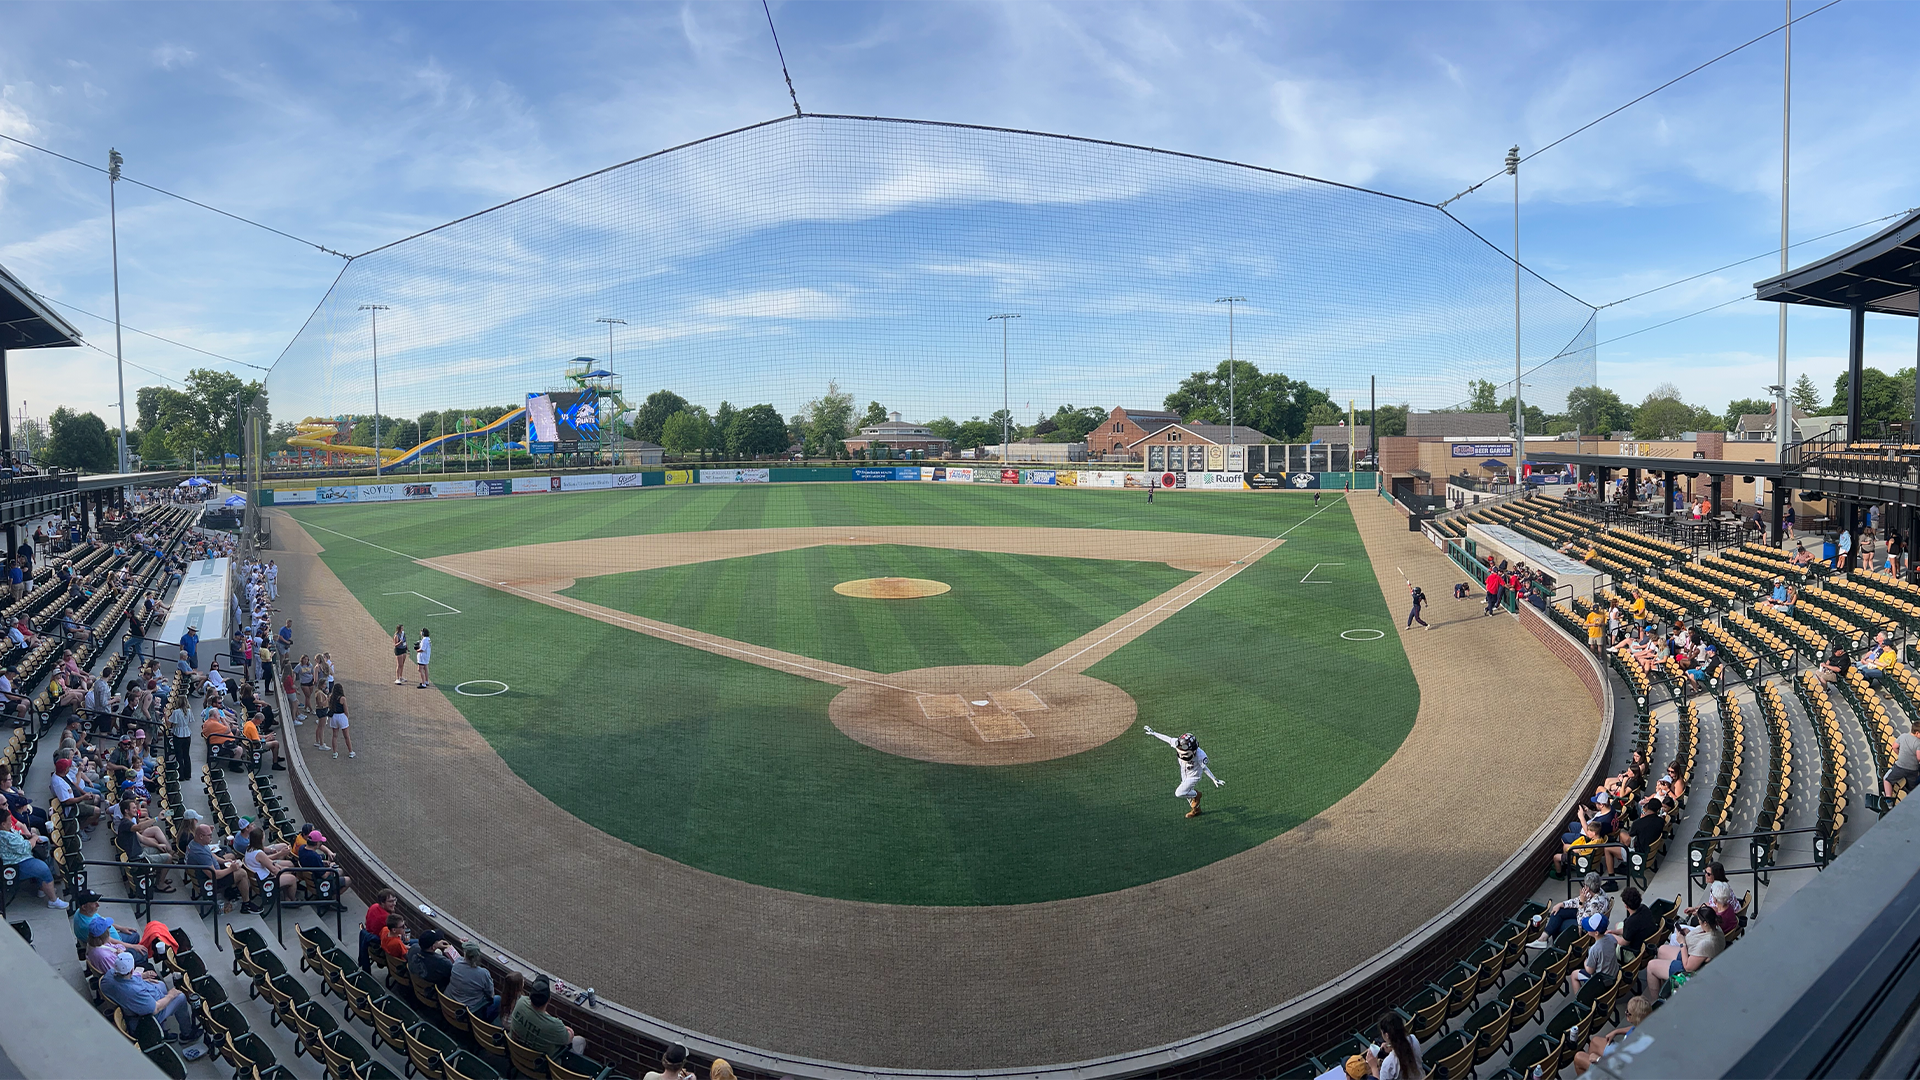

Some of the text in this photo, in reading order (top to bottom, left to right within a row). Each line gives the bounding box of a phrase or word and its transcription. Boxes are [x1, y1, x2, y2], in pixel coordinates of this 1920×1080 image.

[1216, 474, 1242, 483] Ruoff
[363, 485, 394, 498] NOVUS
[515, 1011, 541, 1036] FAITH
